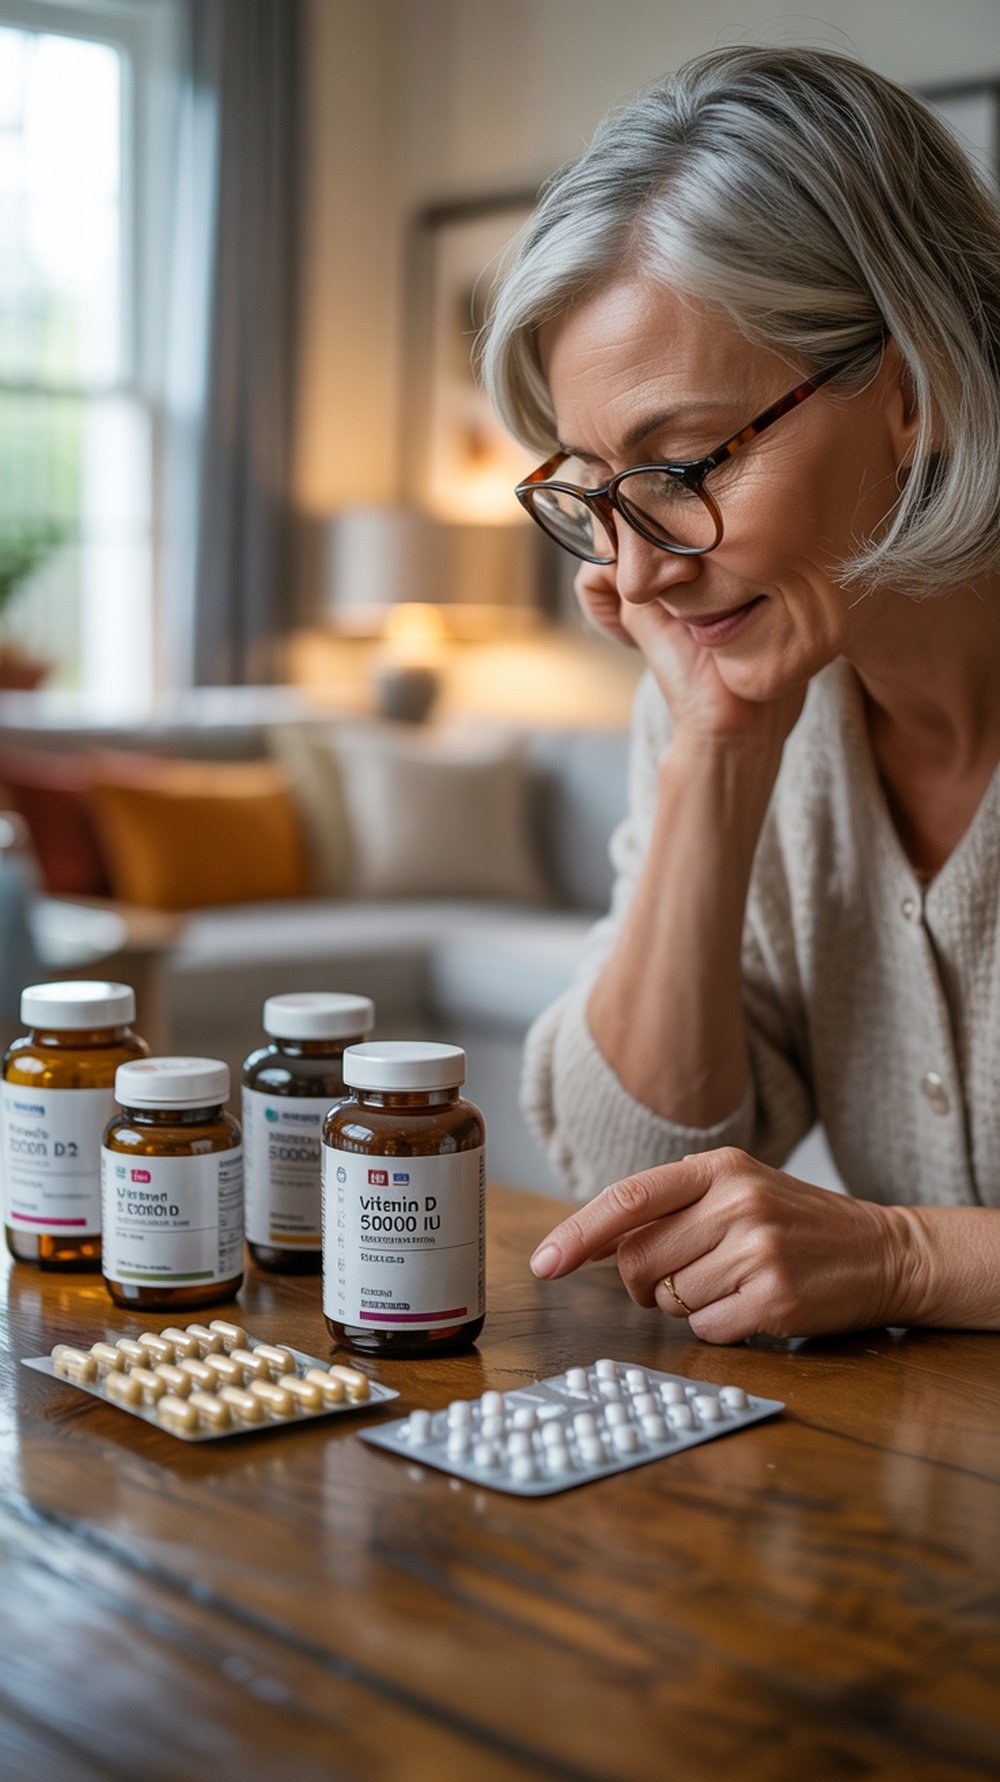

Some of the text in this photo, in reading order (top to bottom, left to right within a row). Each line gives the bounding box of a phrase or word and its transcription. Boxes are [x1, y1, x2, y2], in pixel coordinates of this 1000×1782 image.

[425, 1196, 437, 1212] D
[360, 1214, 441, 1233] 50000 IU
